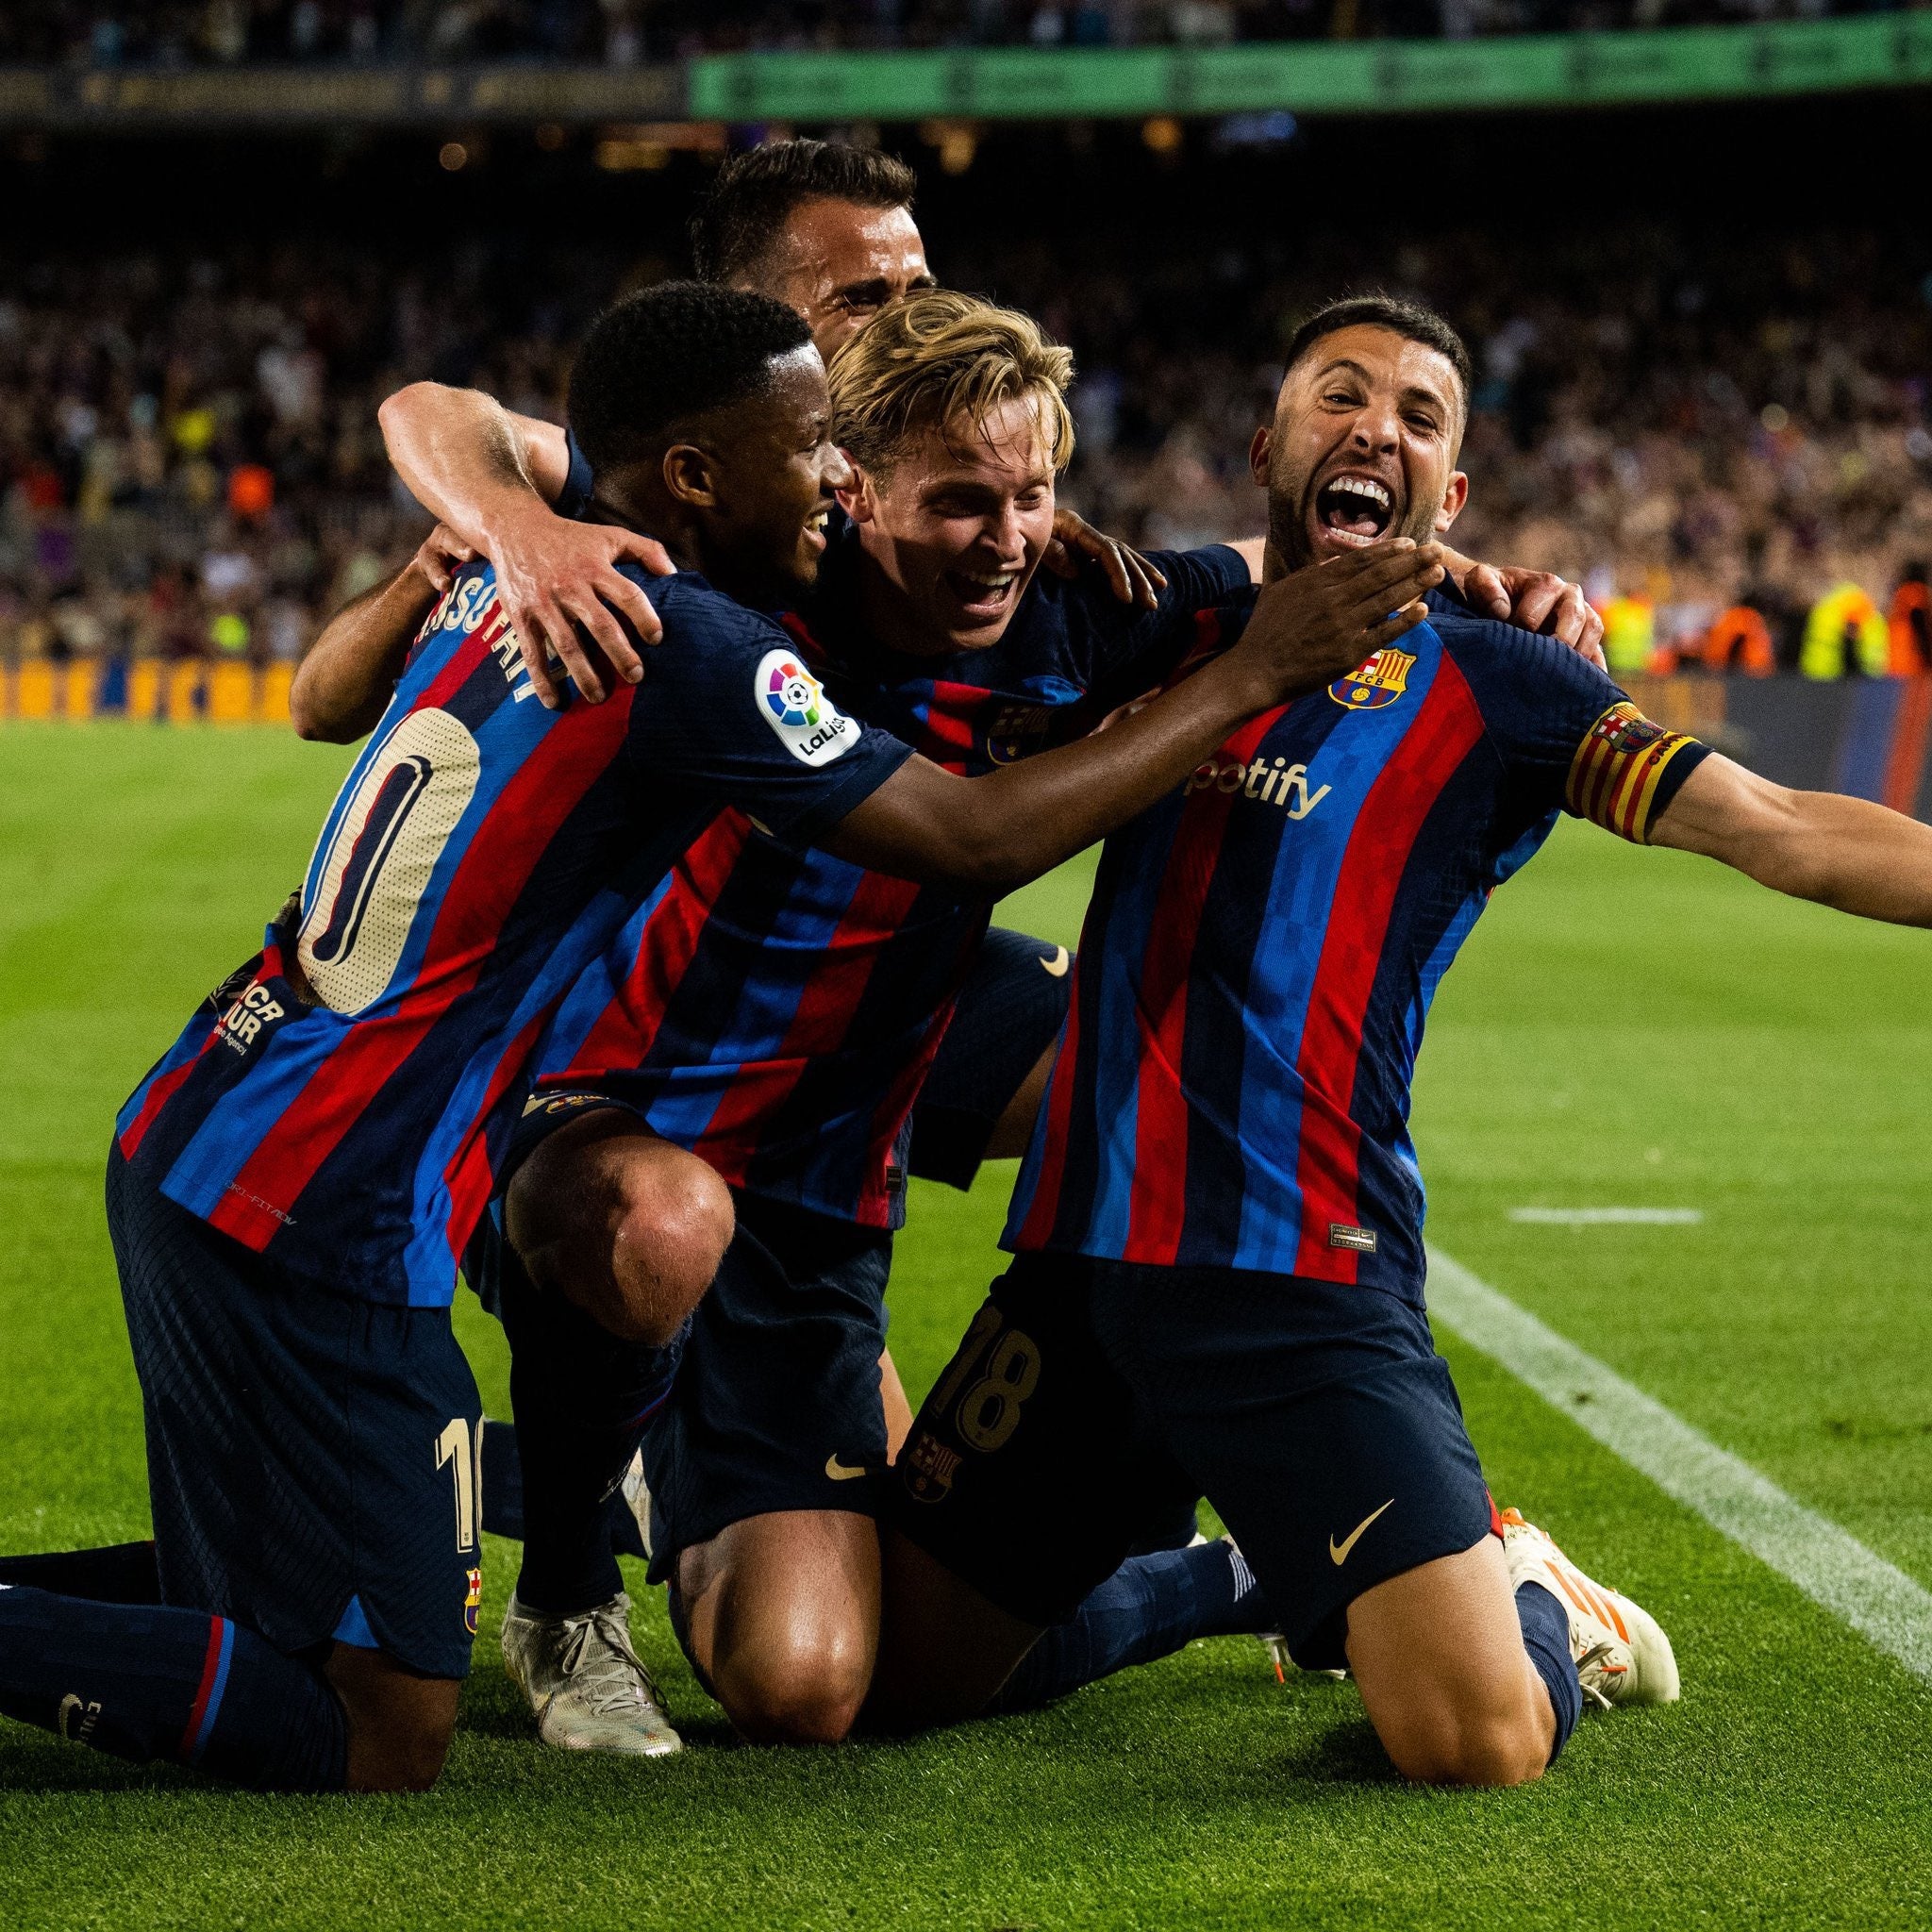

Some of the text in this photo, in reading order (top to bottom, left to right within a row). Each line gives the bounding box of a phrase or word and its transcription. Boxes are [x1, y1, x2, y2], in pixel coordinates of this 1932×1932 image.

[1355, 673, 1384, 687] FCB
[799, 717, 847, 757] LaLiga
[1182, 757, 1333, 821] potify
[931, 1305, 1041, 1454] 18
[434, 1413, 485, 1554] 1
